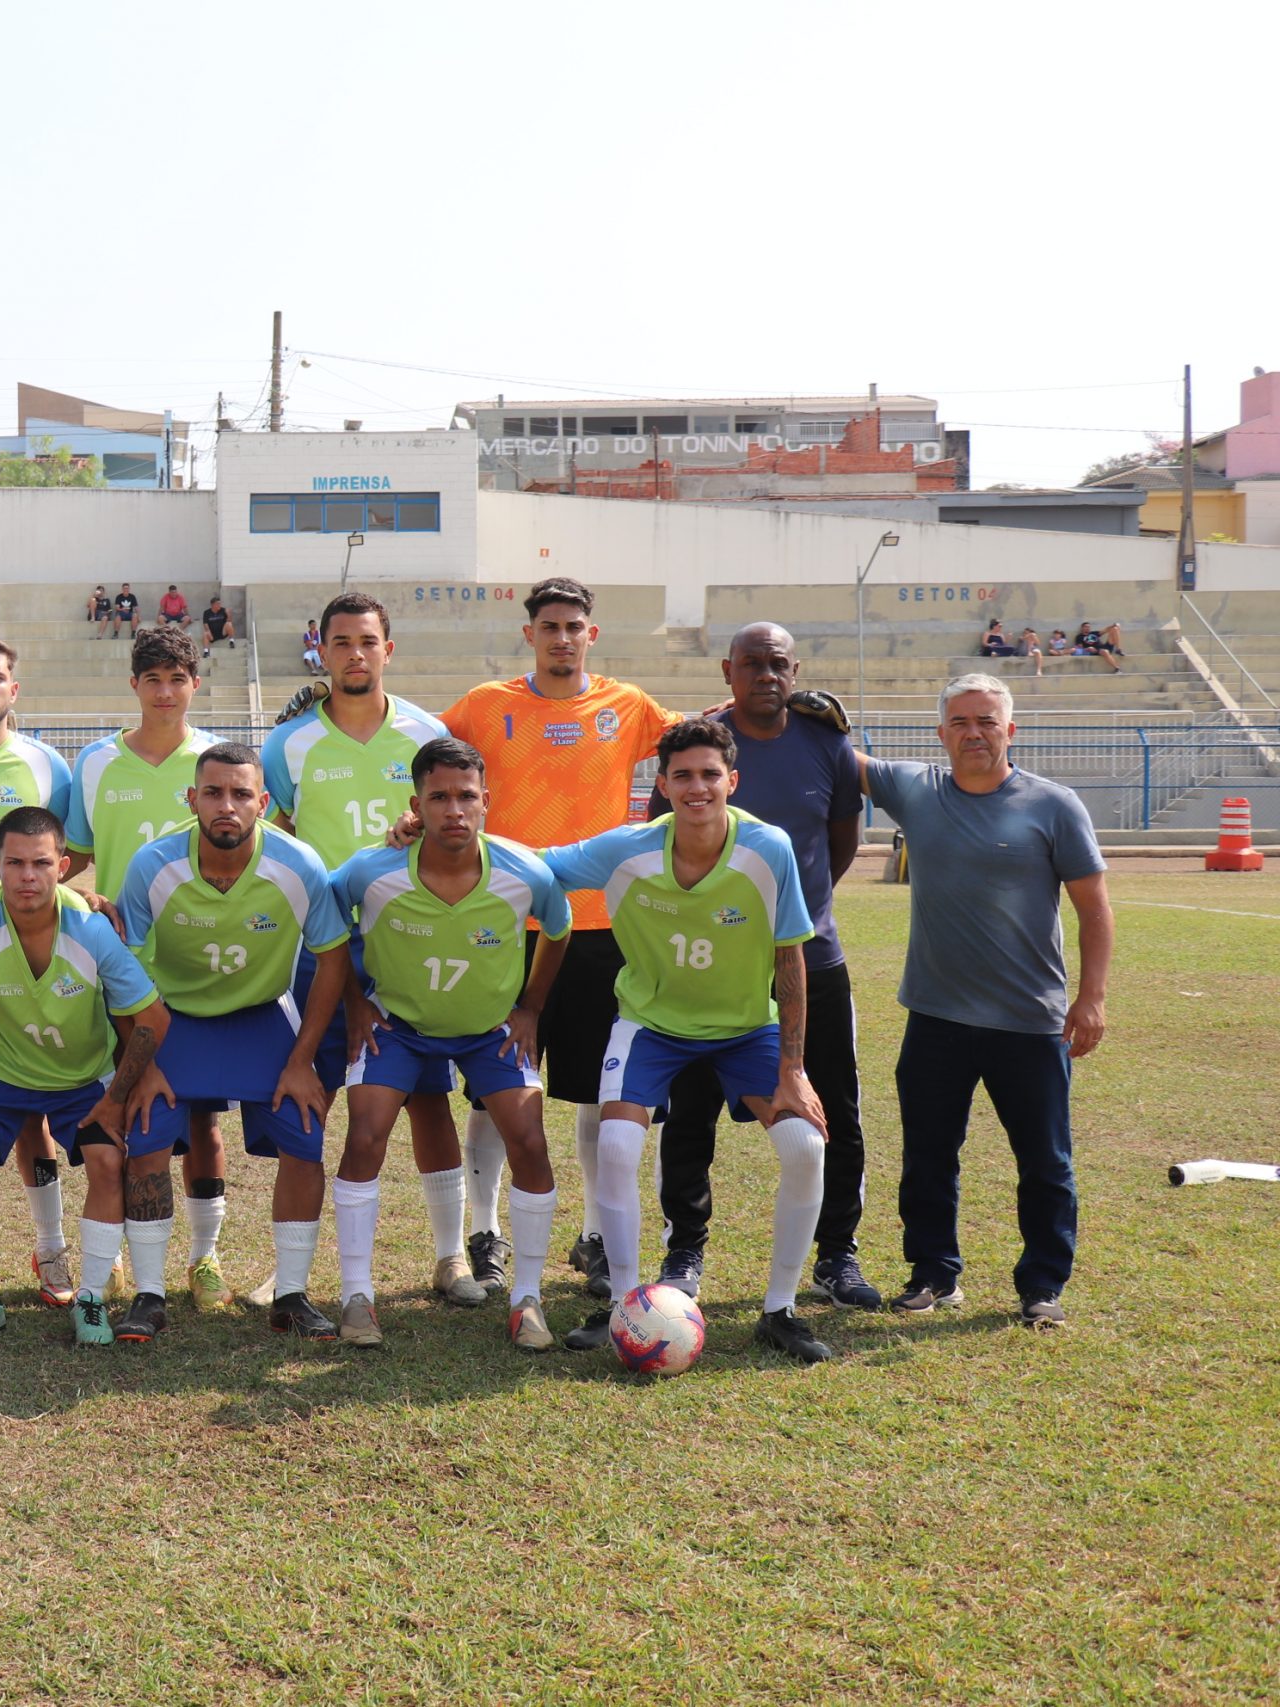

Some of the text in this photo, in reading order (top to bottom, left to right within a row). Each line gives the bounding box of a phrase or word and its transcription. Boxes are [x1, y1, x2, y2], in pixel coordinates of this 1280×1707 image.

[478, 436, 600, 456] MERCADO
[614, 436, 647, 455] DO
[660, 434, 783, 455] TONINHO
[312, 475, 392, 491] IMPRENSA
[415, 586, 515, 601] SETOR 04
[898, 587, 970, 601] SETOR
[503, 714, 513, 740] 1
[545, 722, 581, 731] Secretaria
[554, 730, 584, 738] Esportes
[329, 771, 354, 780] SALTO
[0, 796, 23, 804] Salto
[344, 798, 389, 837] 15
[190, 920, 216, 929] SALTO
[253, 922, 278, 930] Salto
[407, 928, 433, 937] SALTO
[669, 933, 713, 970] 18
[202, 943, 248, 975] 13
[423, 957, 470, 992] 17
[0, 988, 24, 997] SALTO
[61, 984, 85, 996] Salto
[23, 1023, 65, 1049] 11
